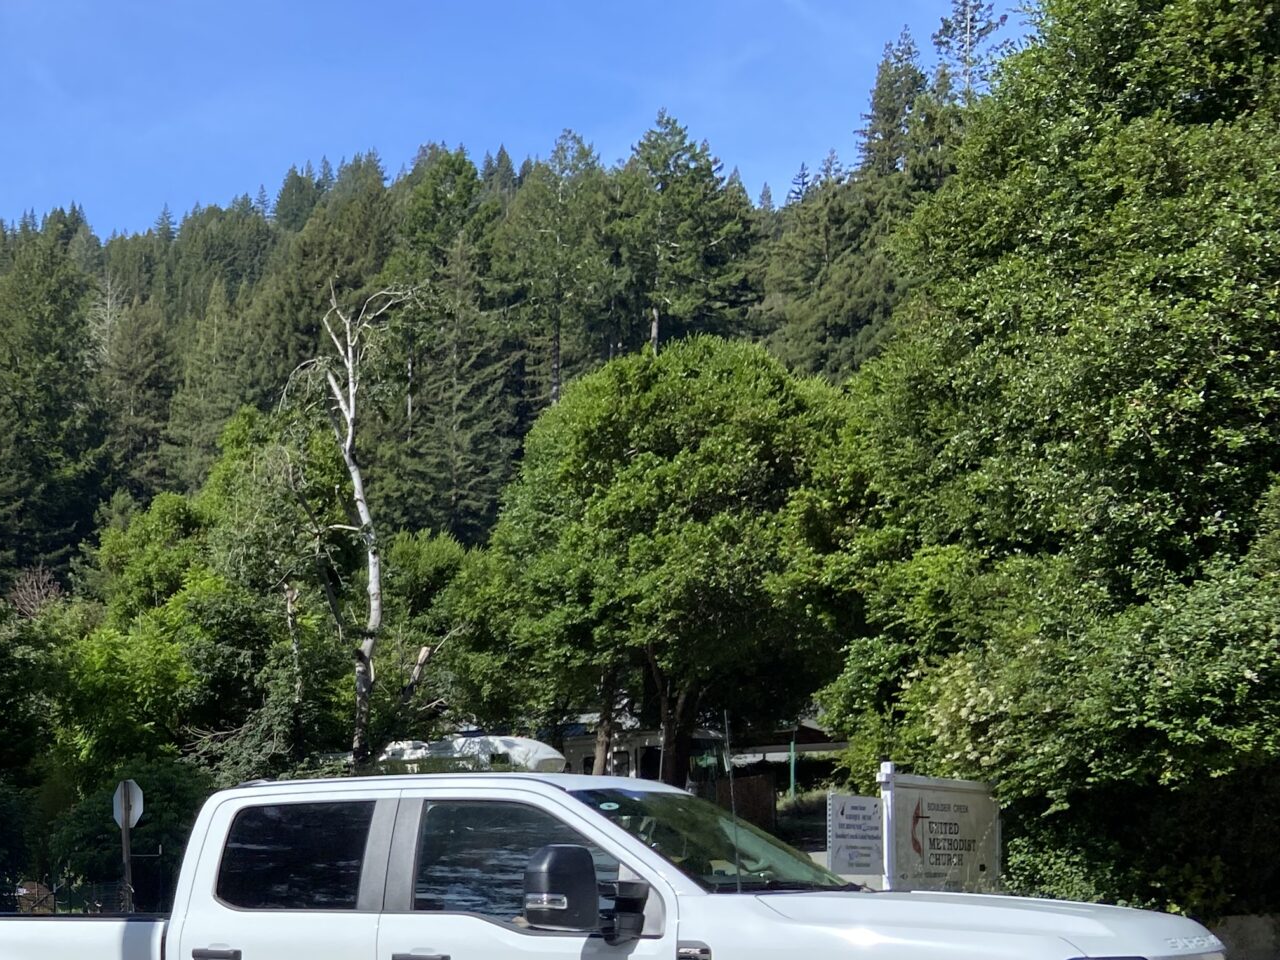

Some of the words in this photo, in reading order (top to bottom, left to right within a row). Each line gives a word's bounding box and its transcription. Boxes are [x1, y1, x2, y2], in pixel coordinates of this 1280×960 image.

[927, 802, 951, 812] BOULDER
[953, 804, 969, 813] CREEK
[928, 821, 960, 834] UNITED
[928, 838, 977, 852] METHODIST
[928, 853, 964, 866] CHURCH
